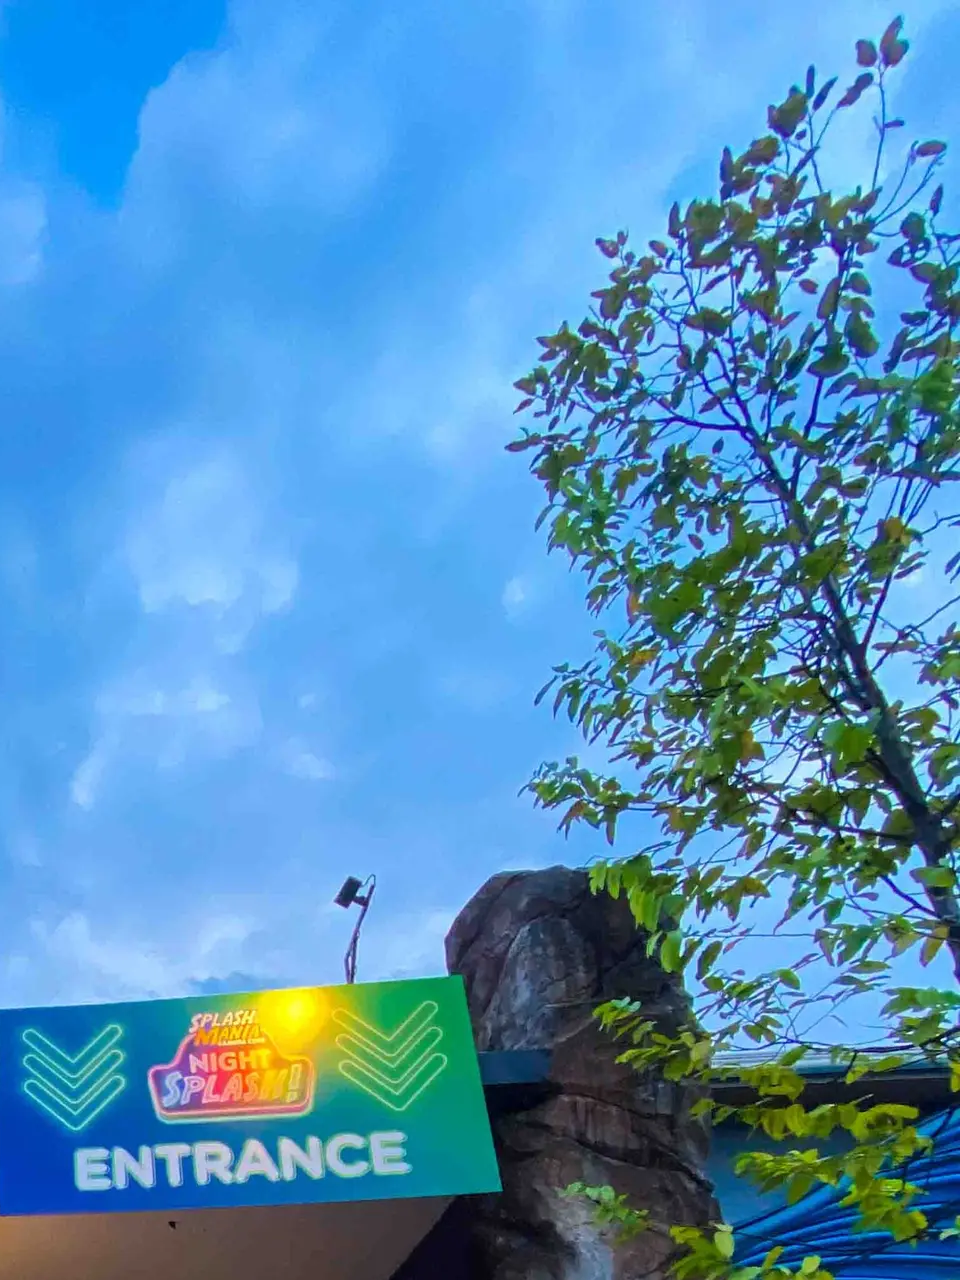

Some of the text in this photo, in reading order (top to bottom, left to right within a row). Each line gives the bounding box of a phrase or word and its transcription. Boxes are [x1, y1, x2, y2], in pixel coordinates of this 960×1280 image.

[188, 1009, 258, 1033] SPLASH
[193, 1025, 261, 1046] MANIA
[188, 1048, 271, 1073] NIGHT
[162, 1063, 302, 1108] SPLASH!
[74, 1130, 413, 1191] ENTRANCE
